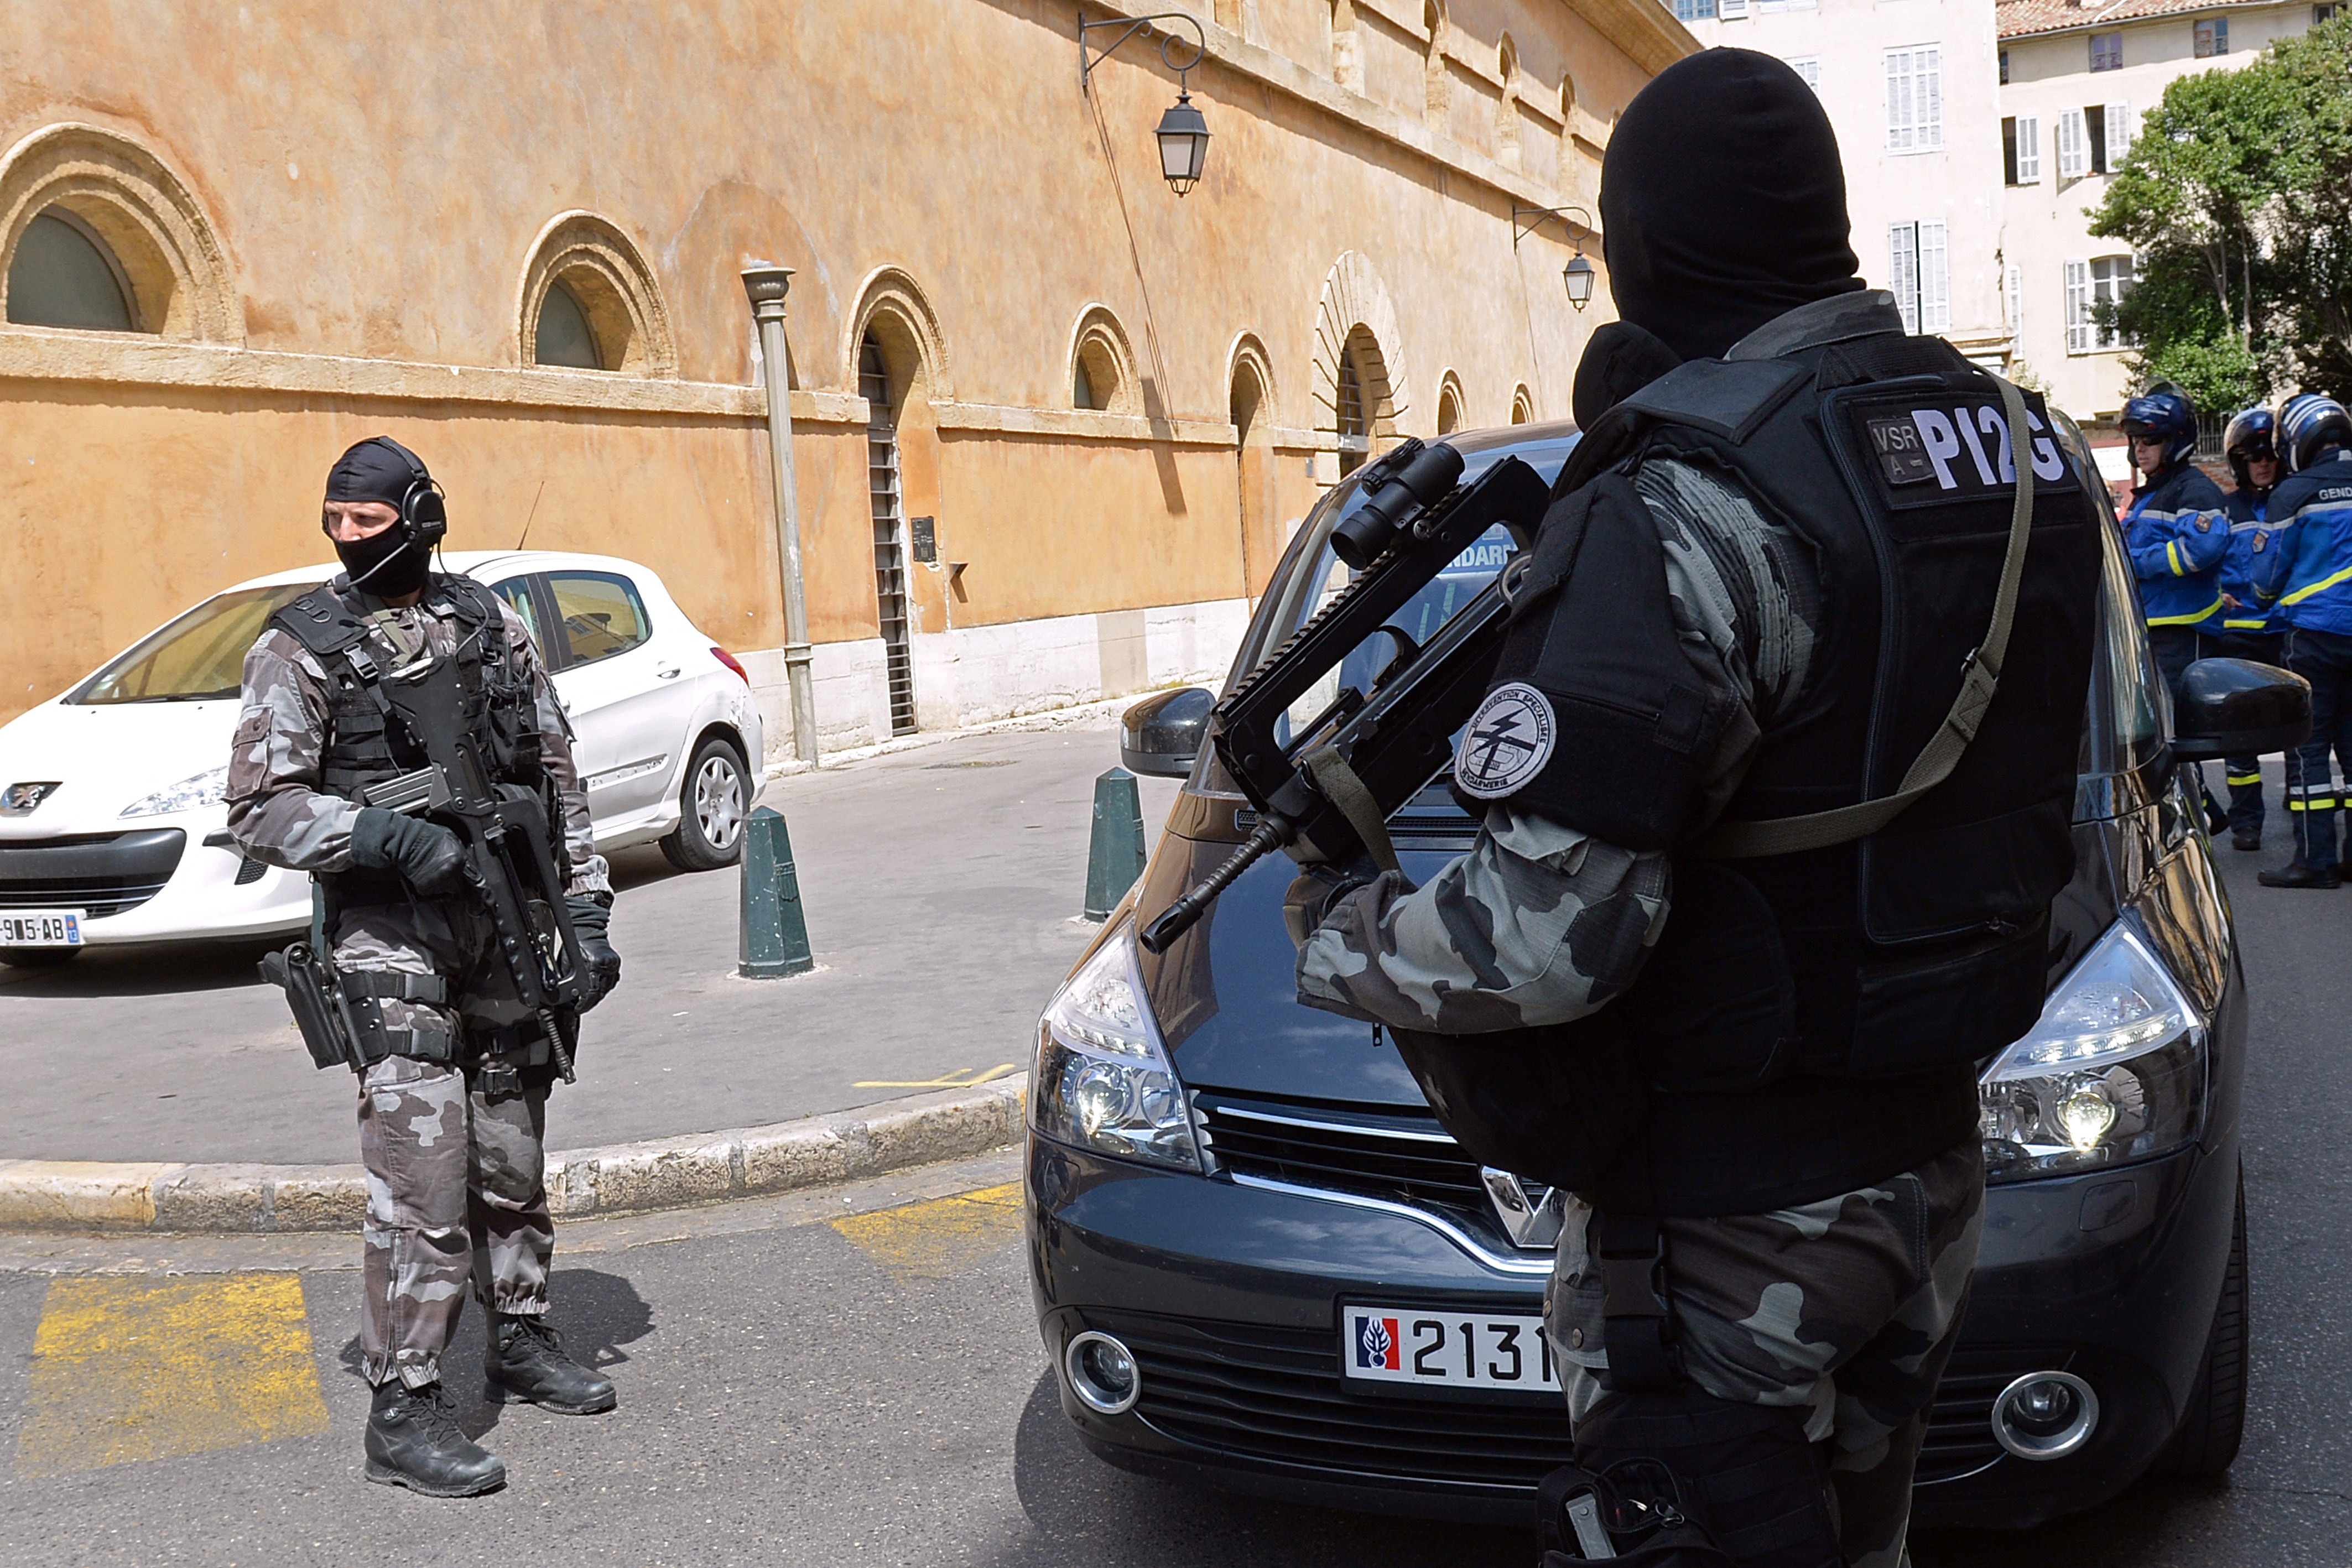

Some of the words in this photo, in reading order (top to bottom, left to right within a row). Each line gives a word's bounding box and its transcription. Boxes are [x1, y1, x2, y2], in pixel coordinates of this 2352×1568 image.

[1873, 426, 1918, 451] VSR
[2318, 487, 2352, 500] GEND
[1413, 1320, 1551, 1382] 2131
